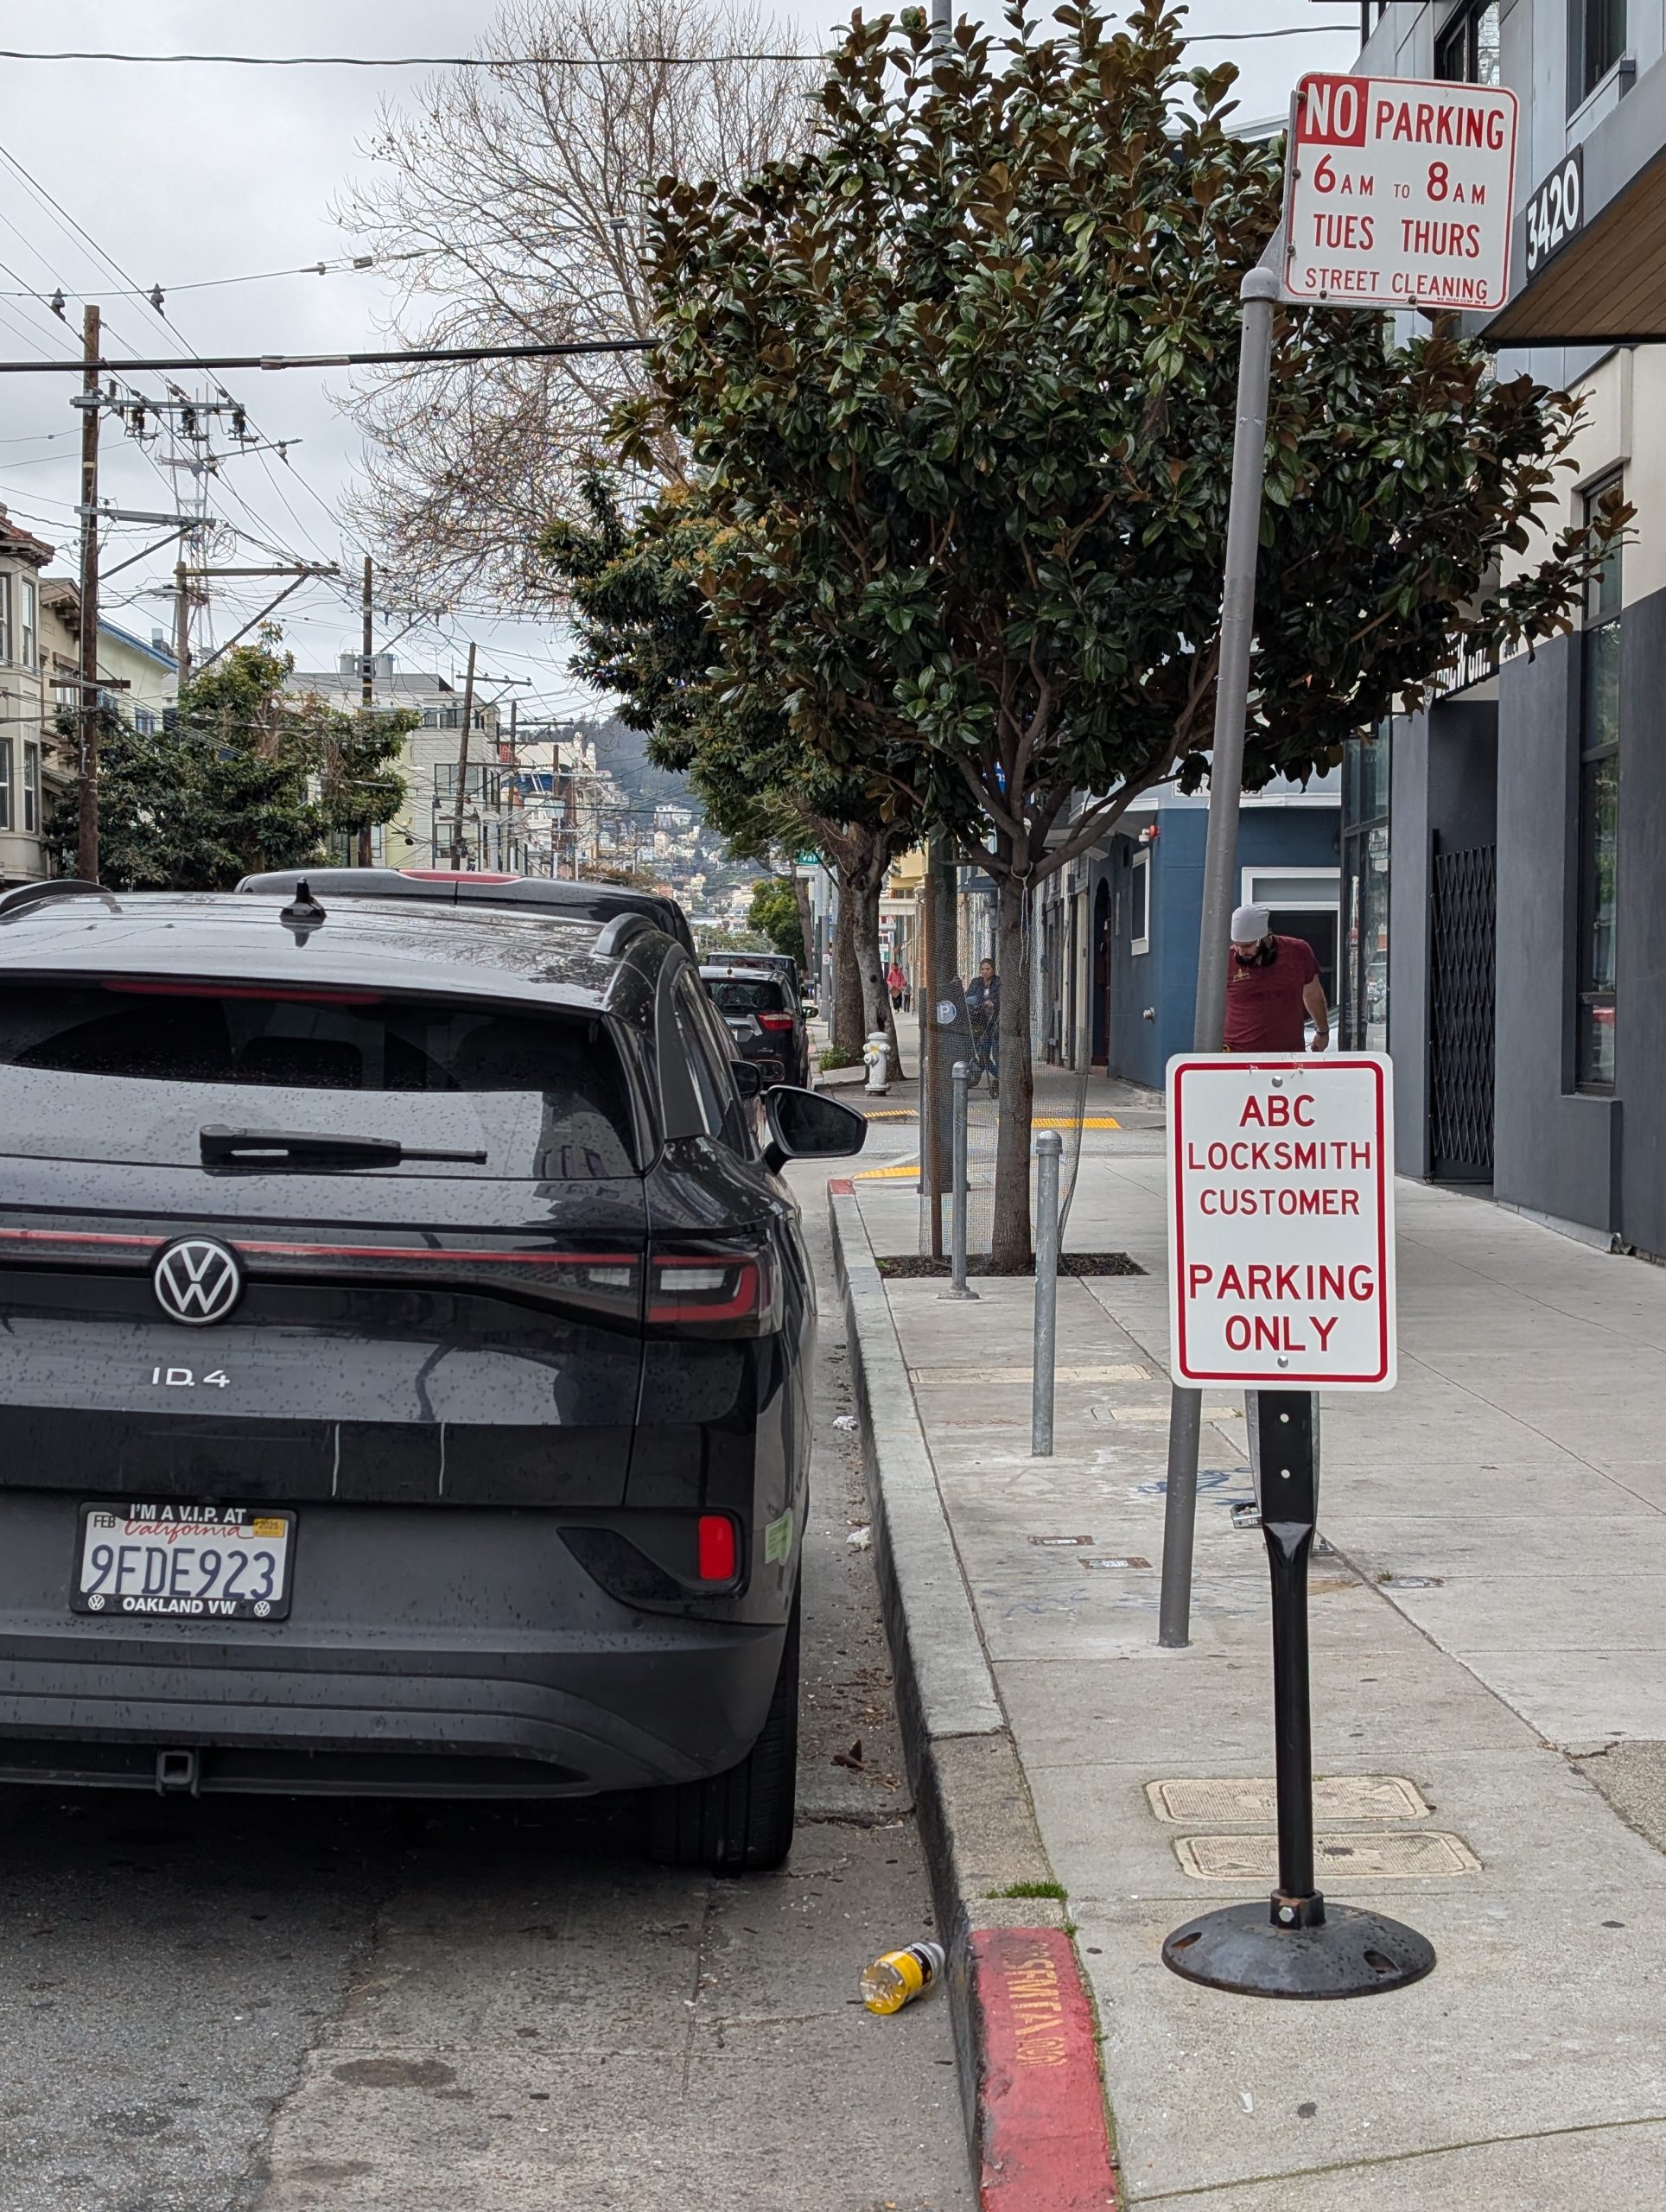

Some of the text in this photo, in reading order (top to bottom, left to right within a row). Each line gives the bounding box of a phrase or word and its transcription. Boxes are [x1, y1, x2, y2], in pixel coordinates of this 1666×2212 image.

[1305, 83, 1504, 150] NO PARKING
[1394, 183, 1410, 199] TO
[1527, 158, 1580, 270] 3420
[1313, 213, 1479, 258] TUES THURS
[1306, 267, 1488, 301] STREET CLEANING
[1239, 1094, 1316, 1128] ABC
[1188, 1141, 1371, 1170] LOCKSMITH
[1200, 1188, 1360, 1216] CUSTOMER
[1189, 1263, 1374, 1301] PARKING
[1224, 1314, 1339, 1352] ONLY
[93, 1514, 116, 1529] FEB
[130, 1503, 246, 1523] I'M A V.I.P. AT
[124, 1520, 254, 1544] California
[86, 1544, 276, 1599] 9FDE923
[123, 1597, 237, 1615] OAKLAND VW
